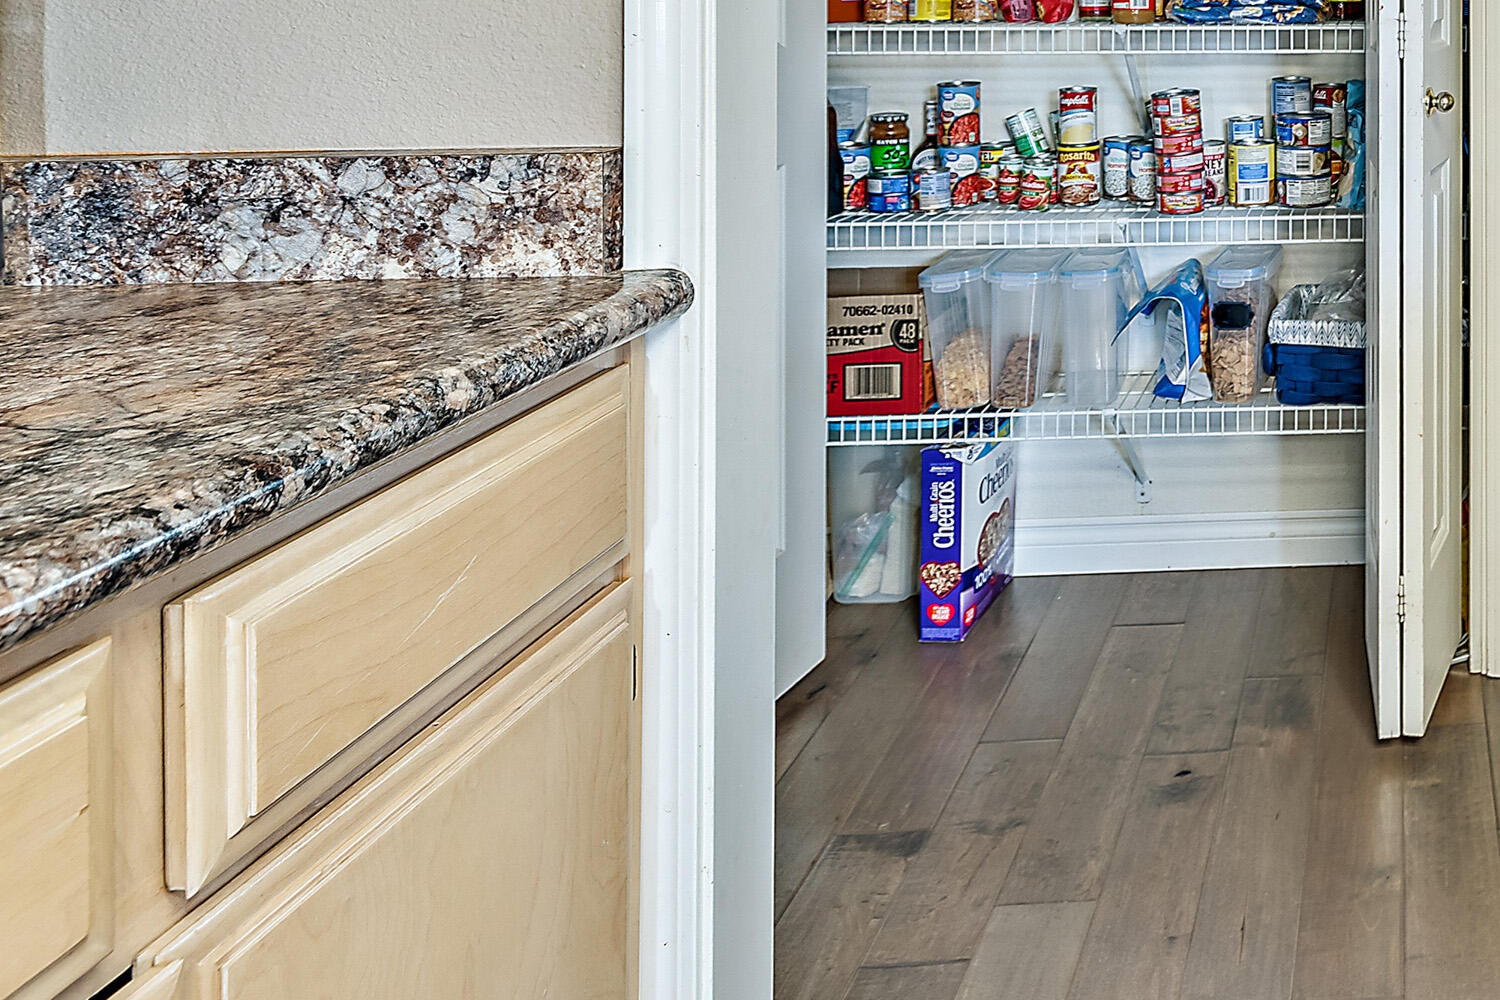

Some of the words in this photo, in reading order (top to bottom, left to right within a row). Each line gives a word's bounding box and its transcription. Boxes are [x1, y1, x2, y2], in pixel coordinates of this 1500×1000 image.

[1204, 160, 1222, 170] NEY
[842, 304, 914, 317] 70662-02410
[827, 323, 884, 337] amen
[899, 323, 916, 339] 48
[843, 337, 865, 346] PACK
[932, 479, 956, 549] Cheerios
